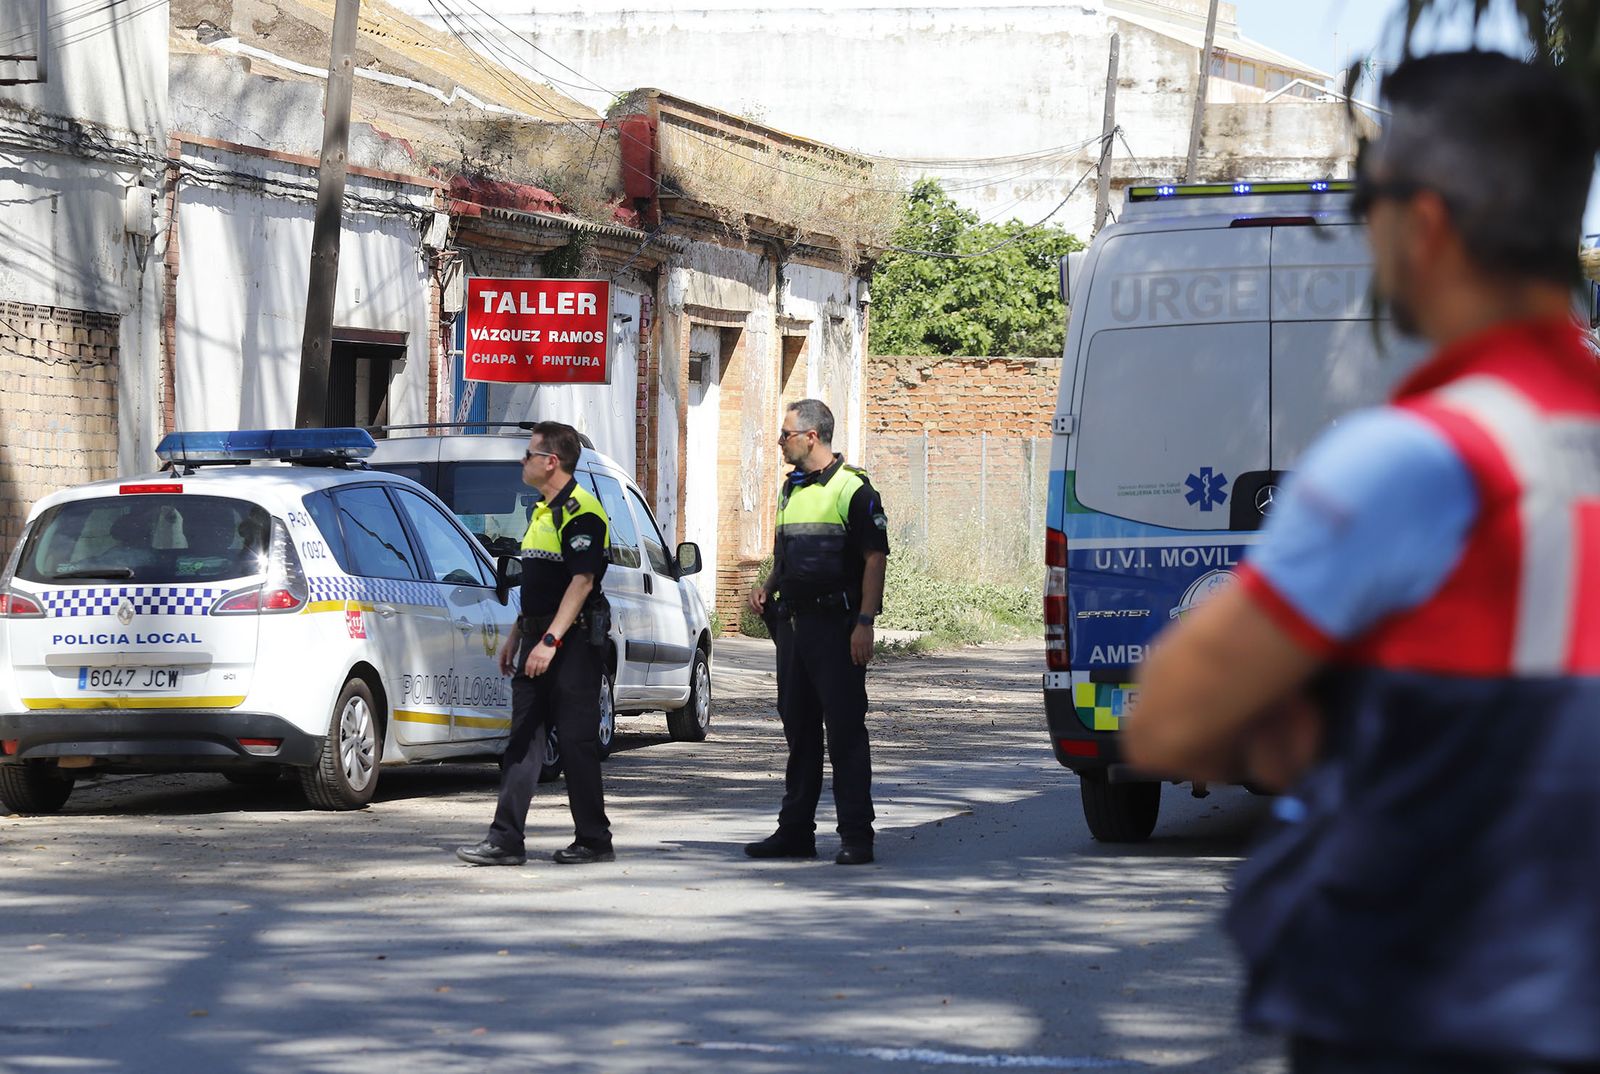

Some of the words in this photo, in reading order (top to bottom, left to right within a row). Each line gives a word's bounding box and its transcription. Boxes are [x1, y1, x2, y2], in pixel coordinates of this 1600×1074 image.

[479, 290, 597, 315] TALLER
[1110, 271, 1373, 323] URGENCI
[470, 326, 541, 343] VÁZQUEZ
[548, 330, 604, 343] RAMOS
[471, 353, 517, 365] CHAPA
[525, 354, 534, 365] Y
[542, 355, 600, 367] PINTURA
[1095, 549, 1152, 569] U.V.I.
[1160, 547, 1238, 568] MOVIL
[1077, 609, 1150, 619] SPRINTER
[53, 633, 130, 645] POLICIA
[136, 633, 203, 644] LOCAL
[90, 669, 136, 688] 6047
[143, 669, 180, 688] JCW
[402, 668, 460, 705] POLICÍA
[463, 677, 507, 706] LOCAL
